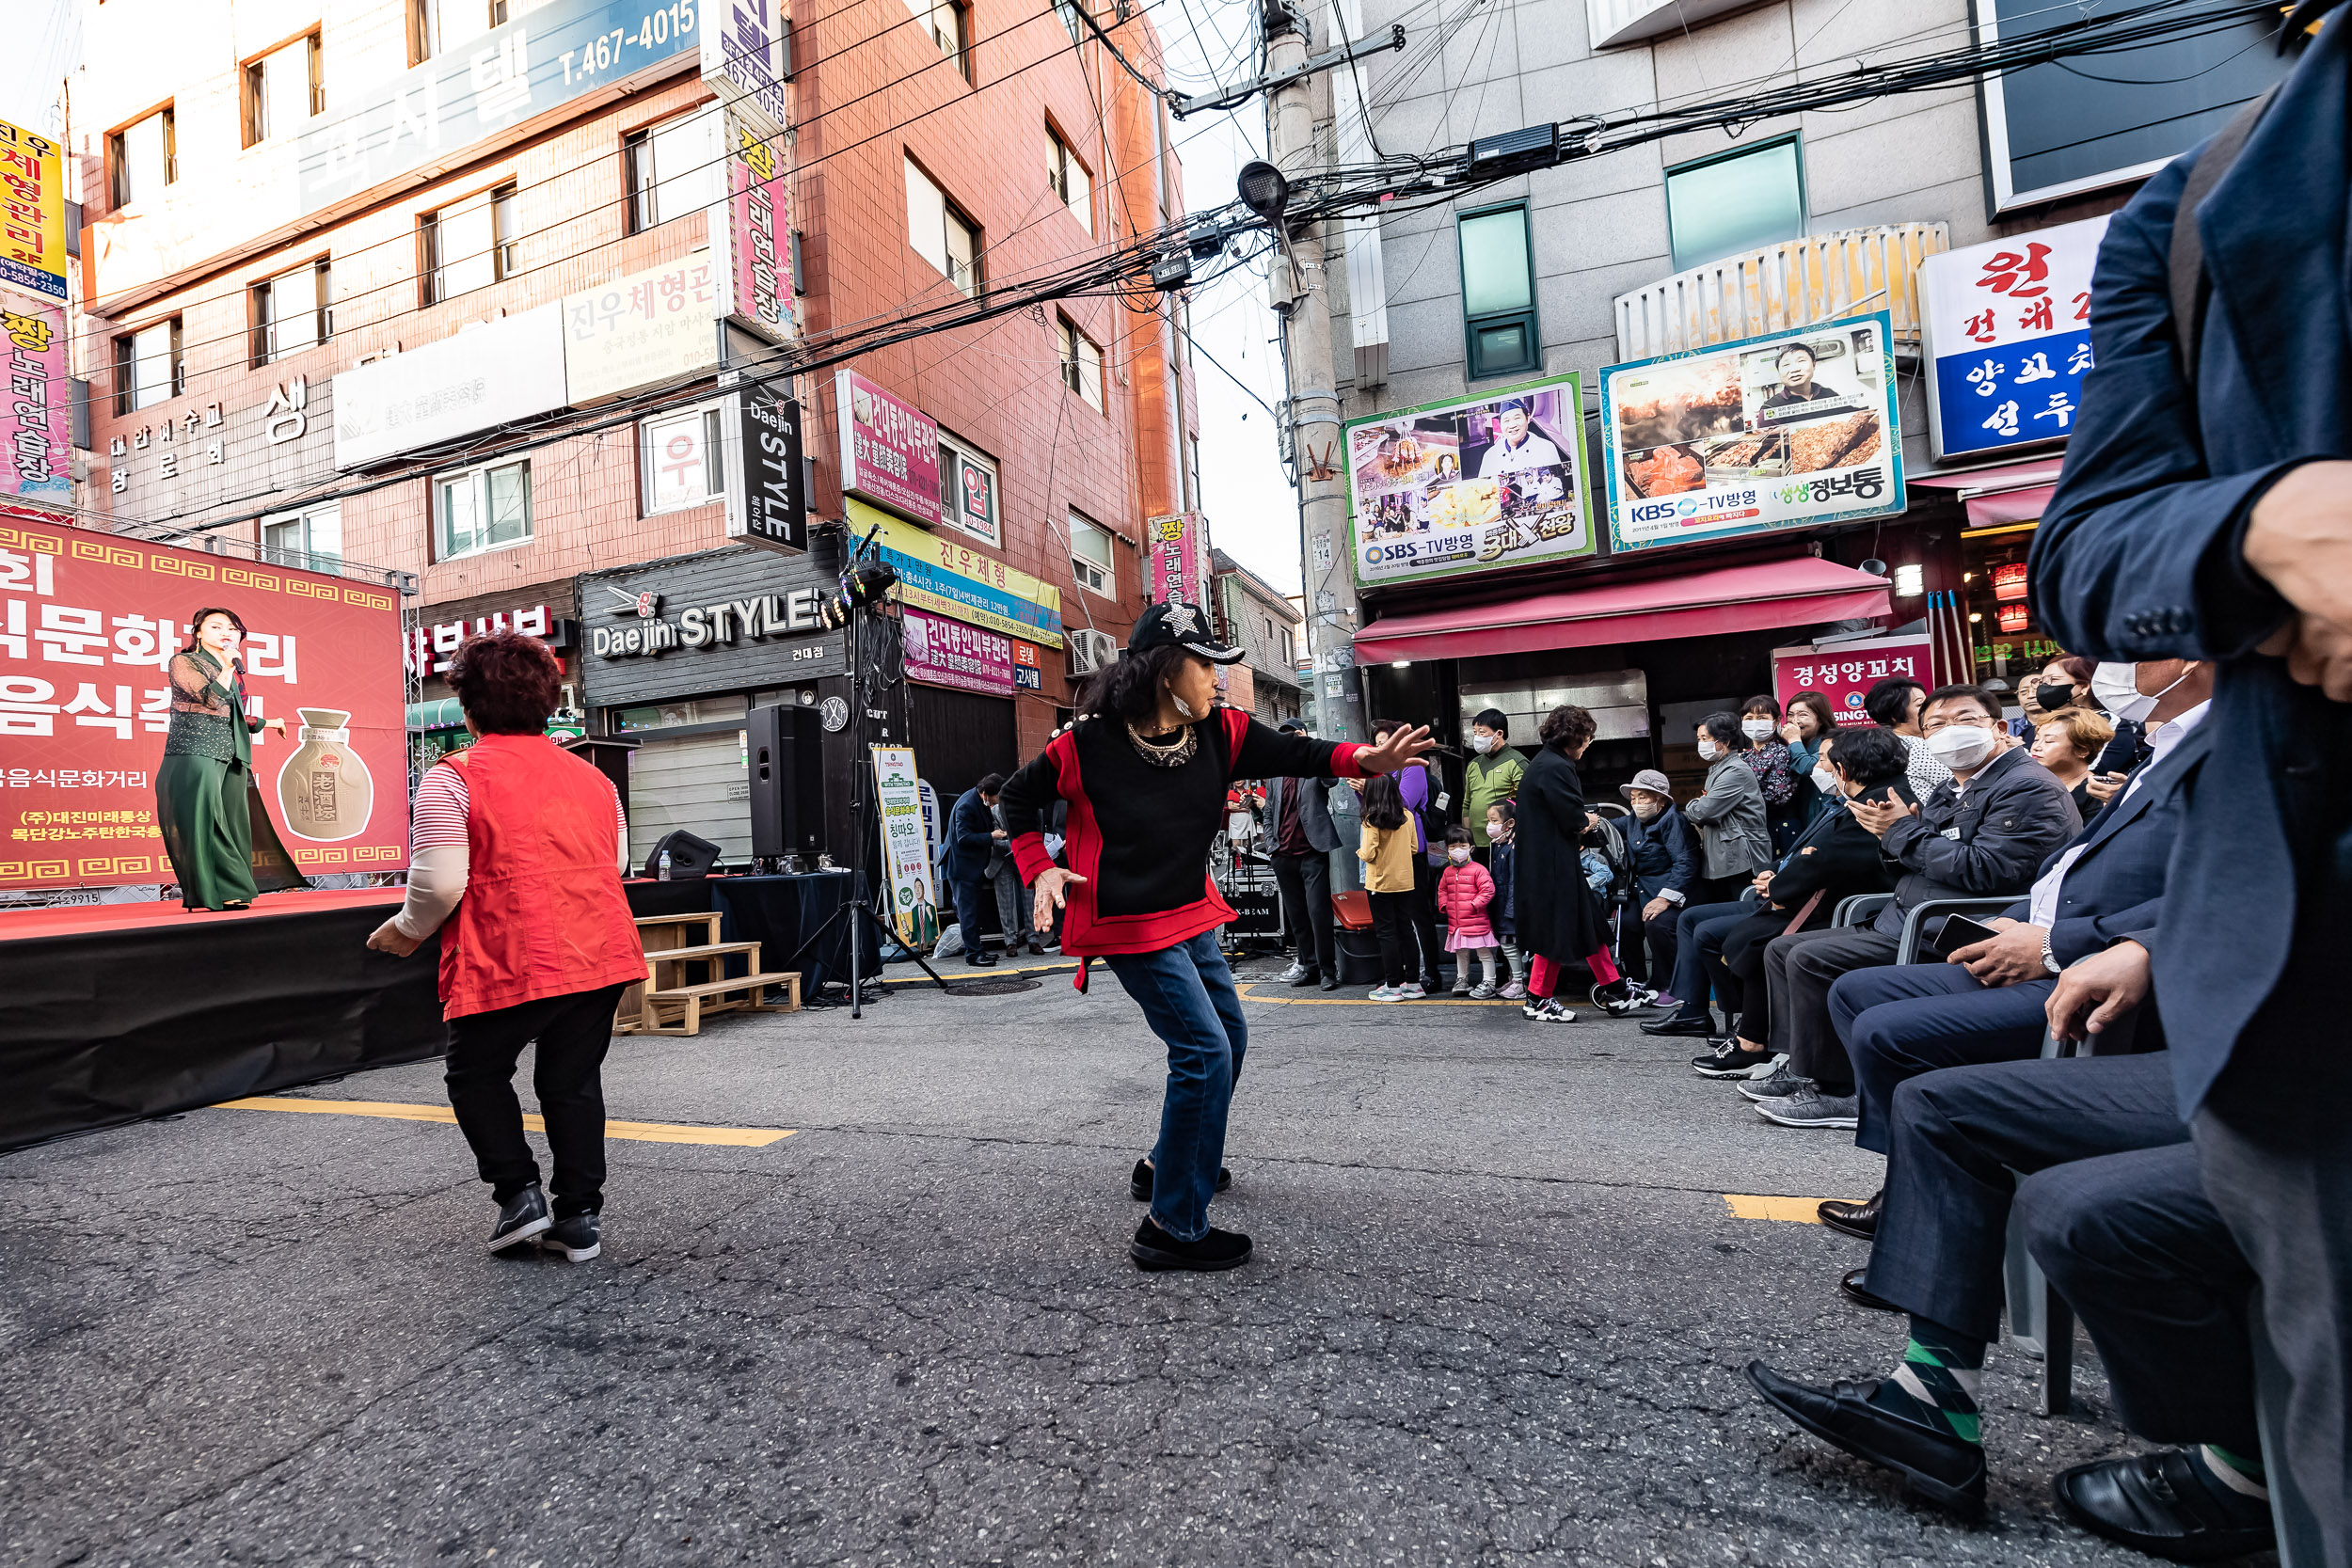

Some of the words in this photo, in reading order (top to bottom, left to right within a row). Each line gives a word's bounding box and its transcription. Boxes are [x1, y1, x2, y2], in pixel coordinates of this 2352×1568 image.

[559, 1, 695, 86] T.467-4015
[723, 56, 784, 125] 467-4015
[739, 128, 775, 182] 짱
[0, 148, 48, 254] 체형관리
[11, 248, 42, 264] 2F
[746, 169, 780, 324] 노래연습장
[1976, 242, 2052, 298] 원
[2, 310, 54, 353] 짱
[9, 348, 54, 483] 노래연습장
[262, 373, 308, 446] 생
[750, 401, 793, 436] Daejin
[872, 392, 938, 469] 건대동안피부관리
[110, 439, 225, 493] 장로회
[661, 435, 700, 485] 우
[760, 432, 791, 541] STYLE
[963, 466, 989, 519] 압
[1780, 467, 1885, 504] 생생정보통
[965, 514, 993, 534] 10-1984
[1160, 519, 1184, 541] 짱
[1631, 502, 1676, 523] KBS
[0, 548, 54, 596] 회
[940, 541, 1006, 589] 진우체형
[1164, 543, 1184, 604] 노래연습
[1318, 548, 1329, 560] 14
[593, 620, 675, 657] Daejin
[679, 587, 818, 647] STYLE
[927, 618, 1011, 665] 건대동안피부관리
[792, 646, 824, 661] 건대점
[1793, 656, 1915, 687] 경성양꼬치
[1016, 667, 1040, 689] 고시텔
[0, 675, 264, 745] 음식
[866, 708, 888, 720] CUT
[1835, 709, 1870, 721] SINGT
[10, 825, 163, 842] 목단강노주탄한국총
[21, 810, 152, 826] (주)대진미래통상
